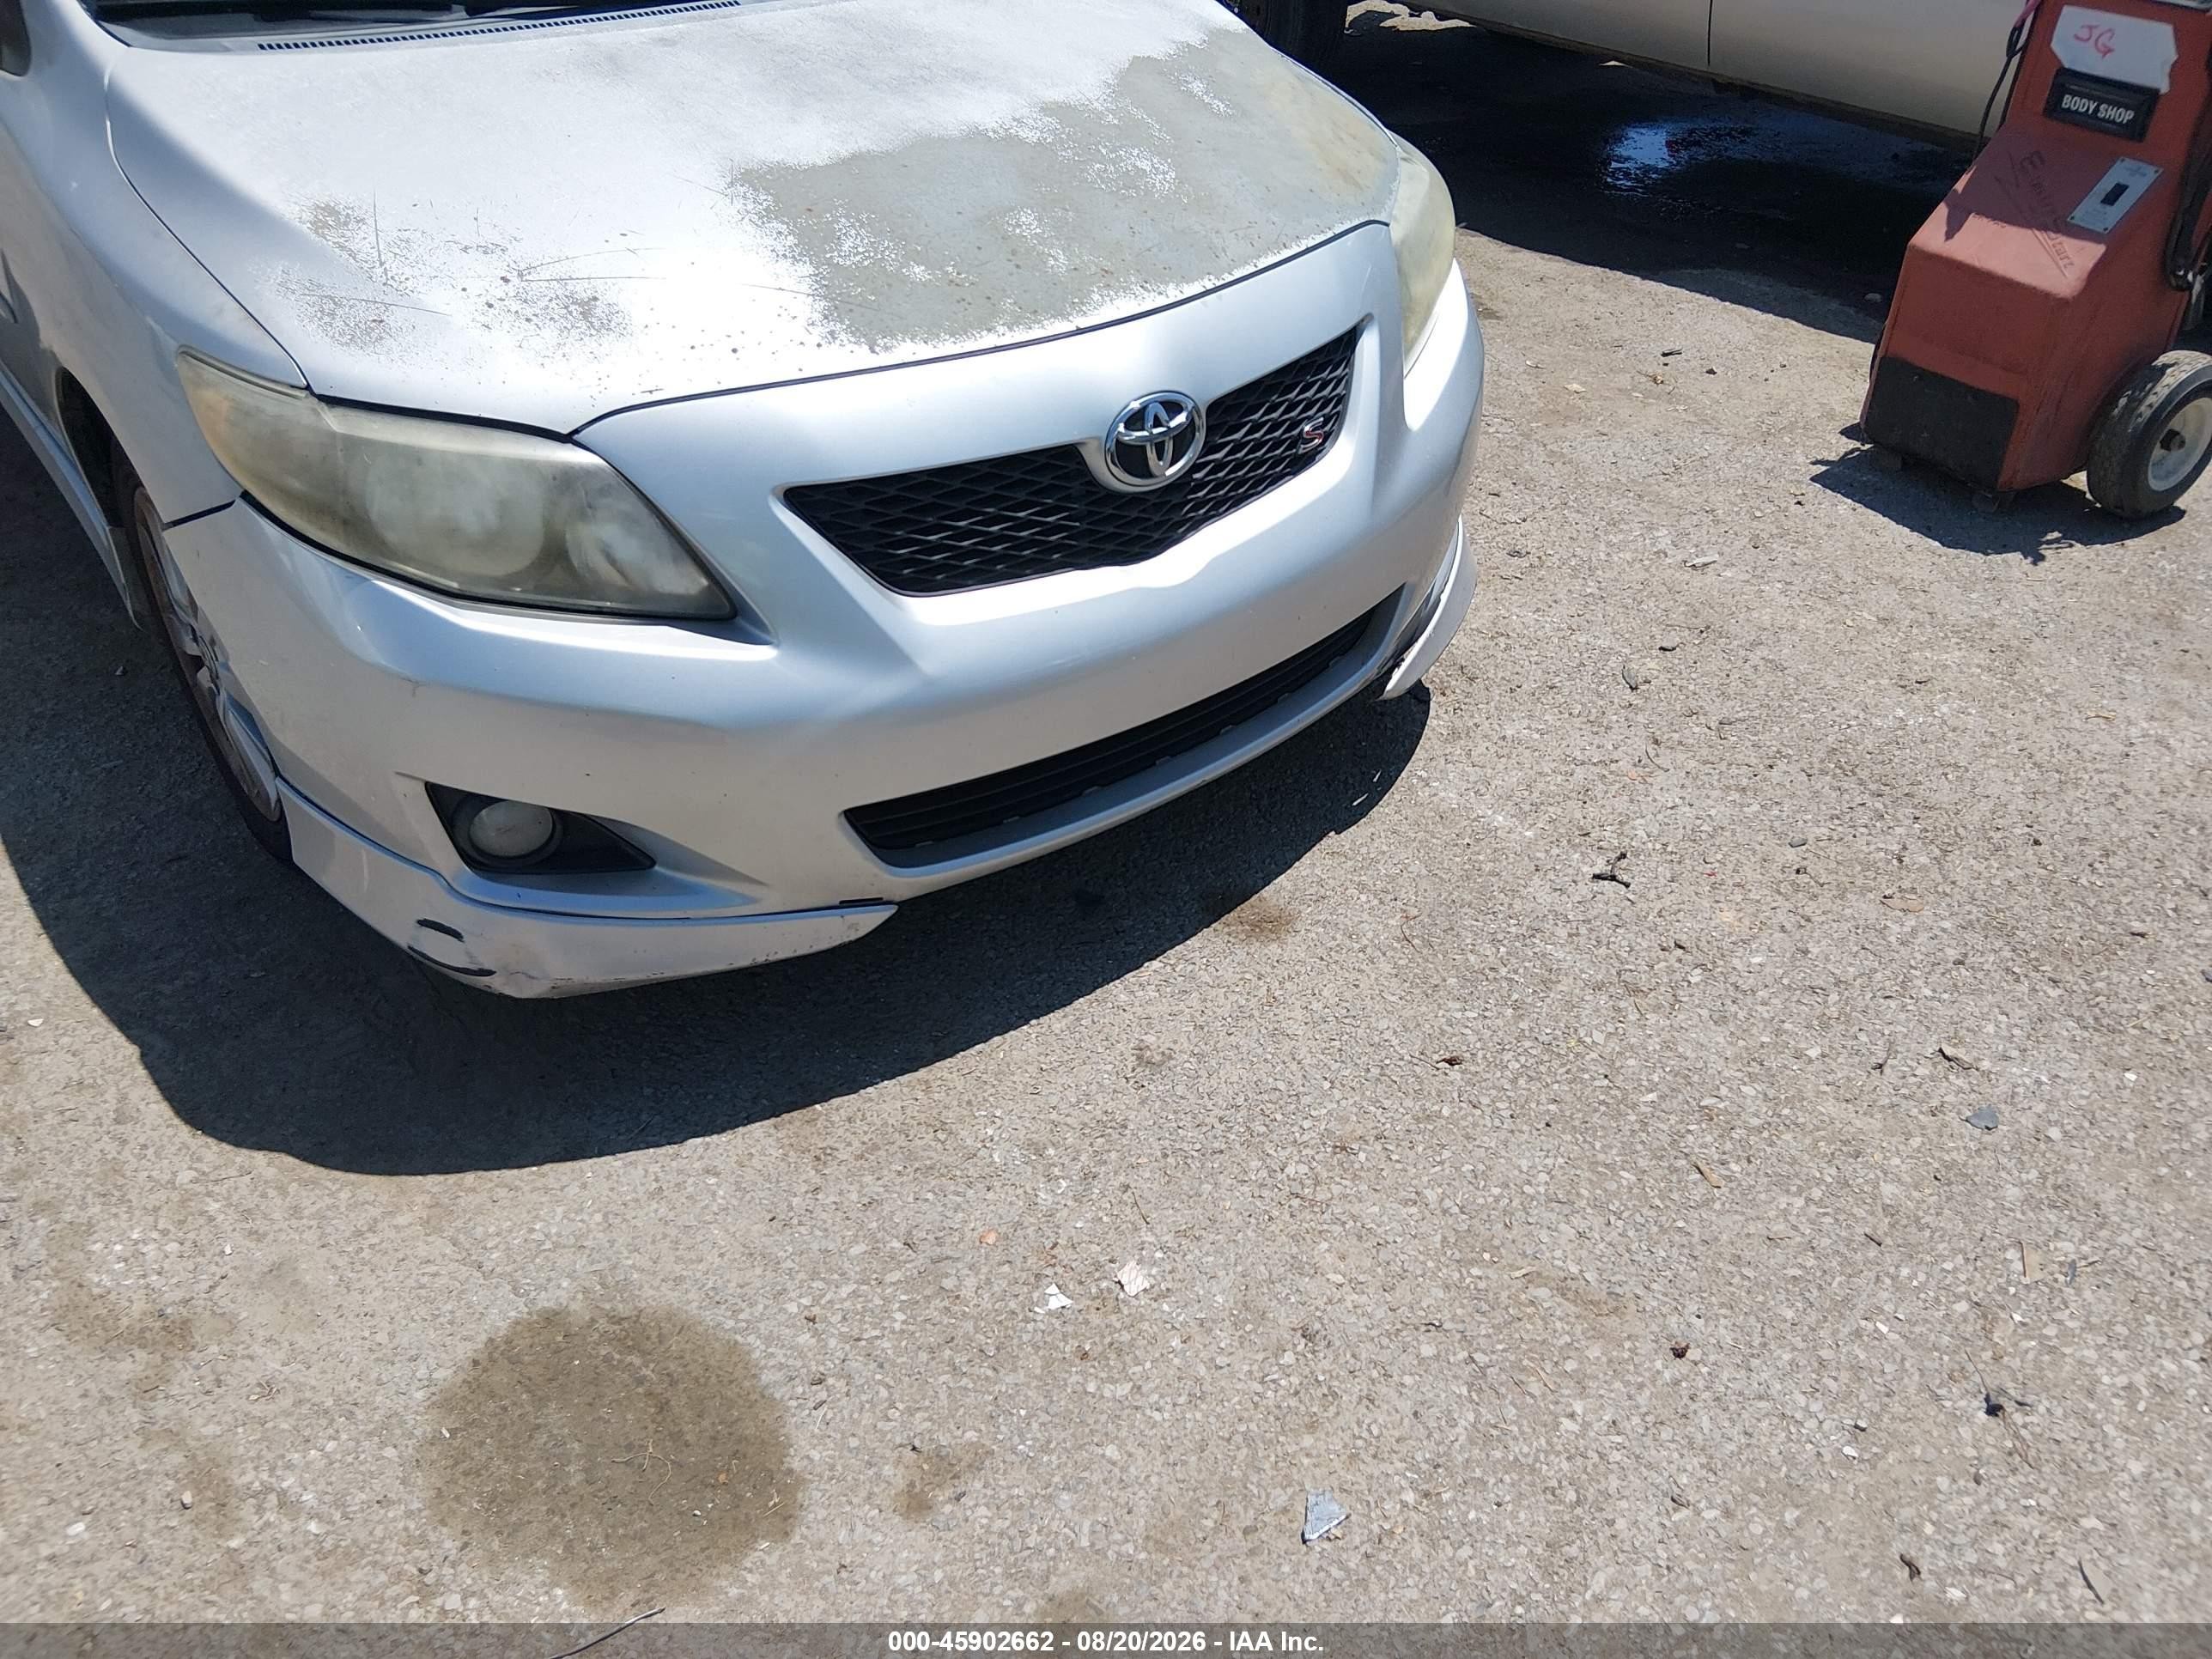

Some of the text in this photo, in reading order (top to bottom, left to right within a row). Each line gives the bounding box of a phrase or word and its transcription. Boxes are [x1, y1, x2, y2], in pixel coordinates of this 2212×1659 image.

[2061, 94, 2135, 125] BODY SHOP
[1298, 416, 1324, 454] S
